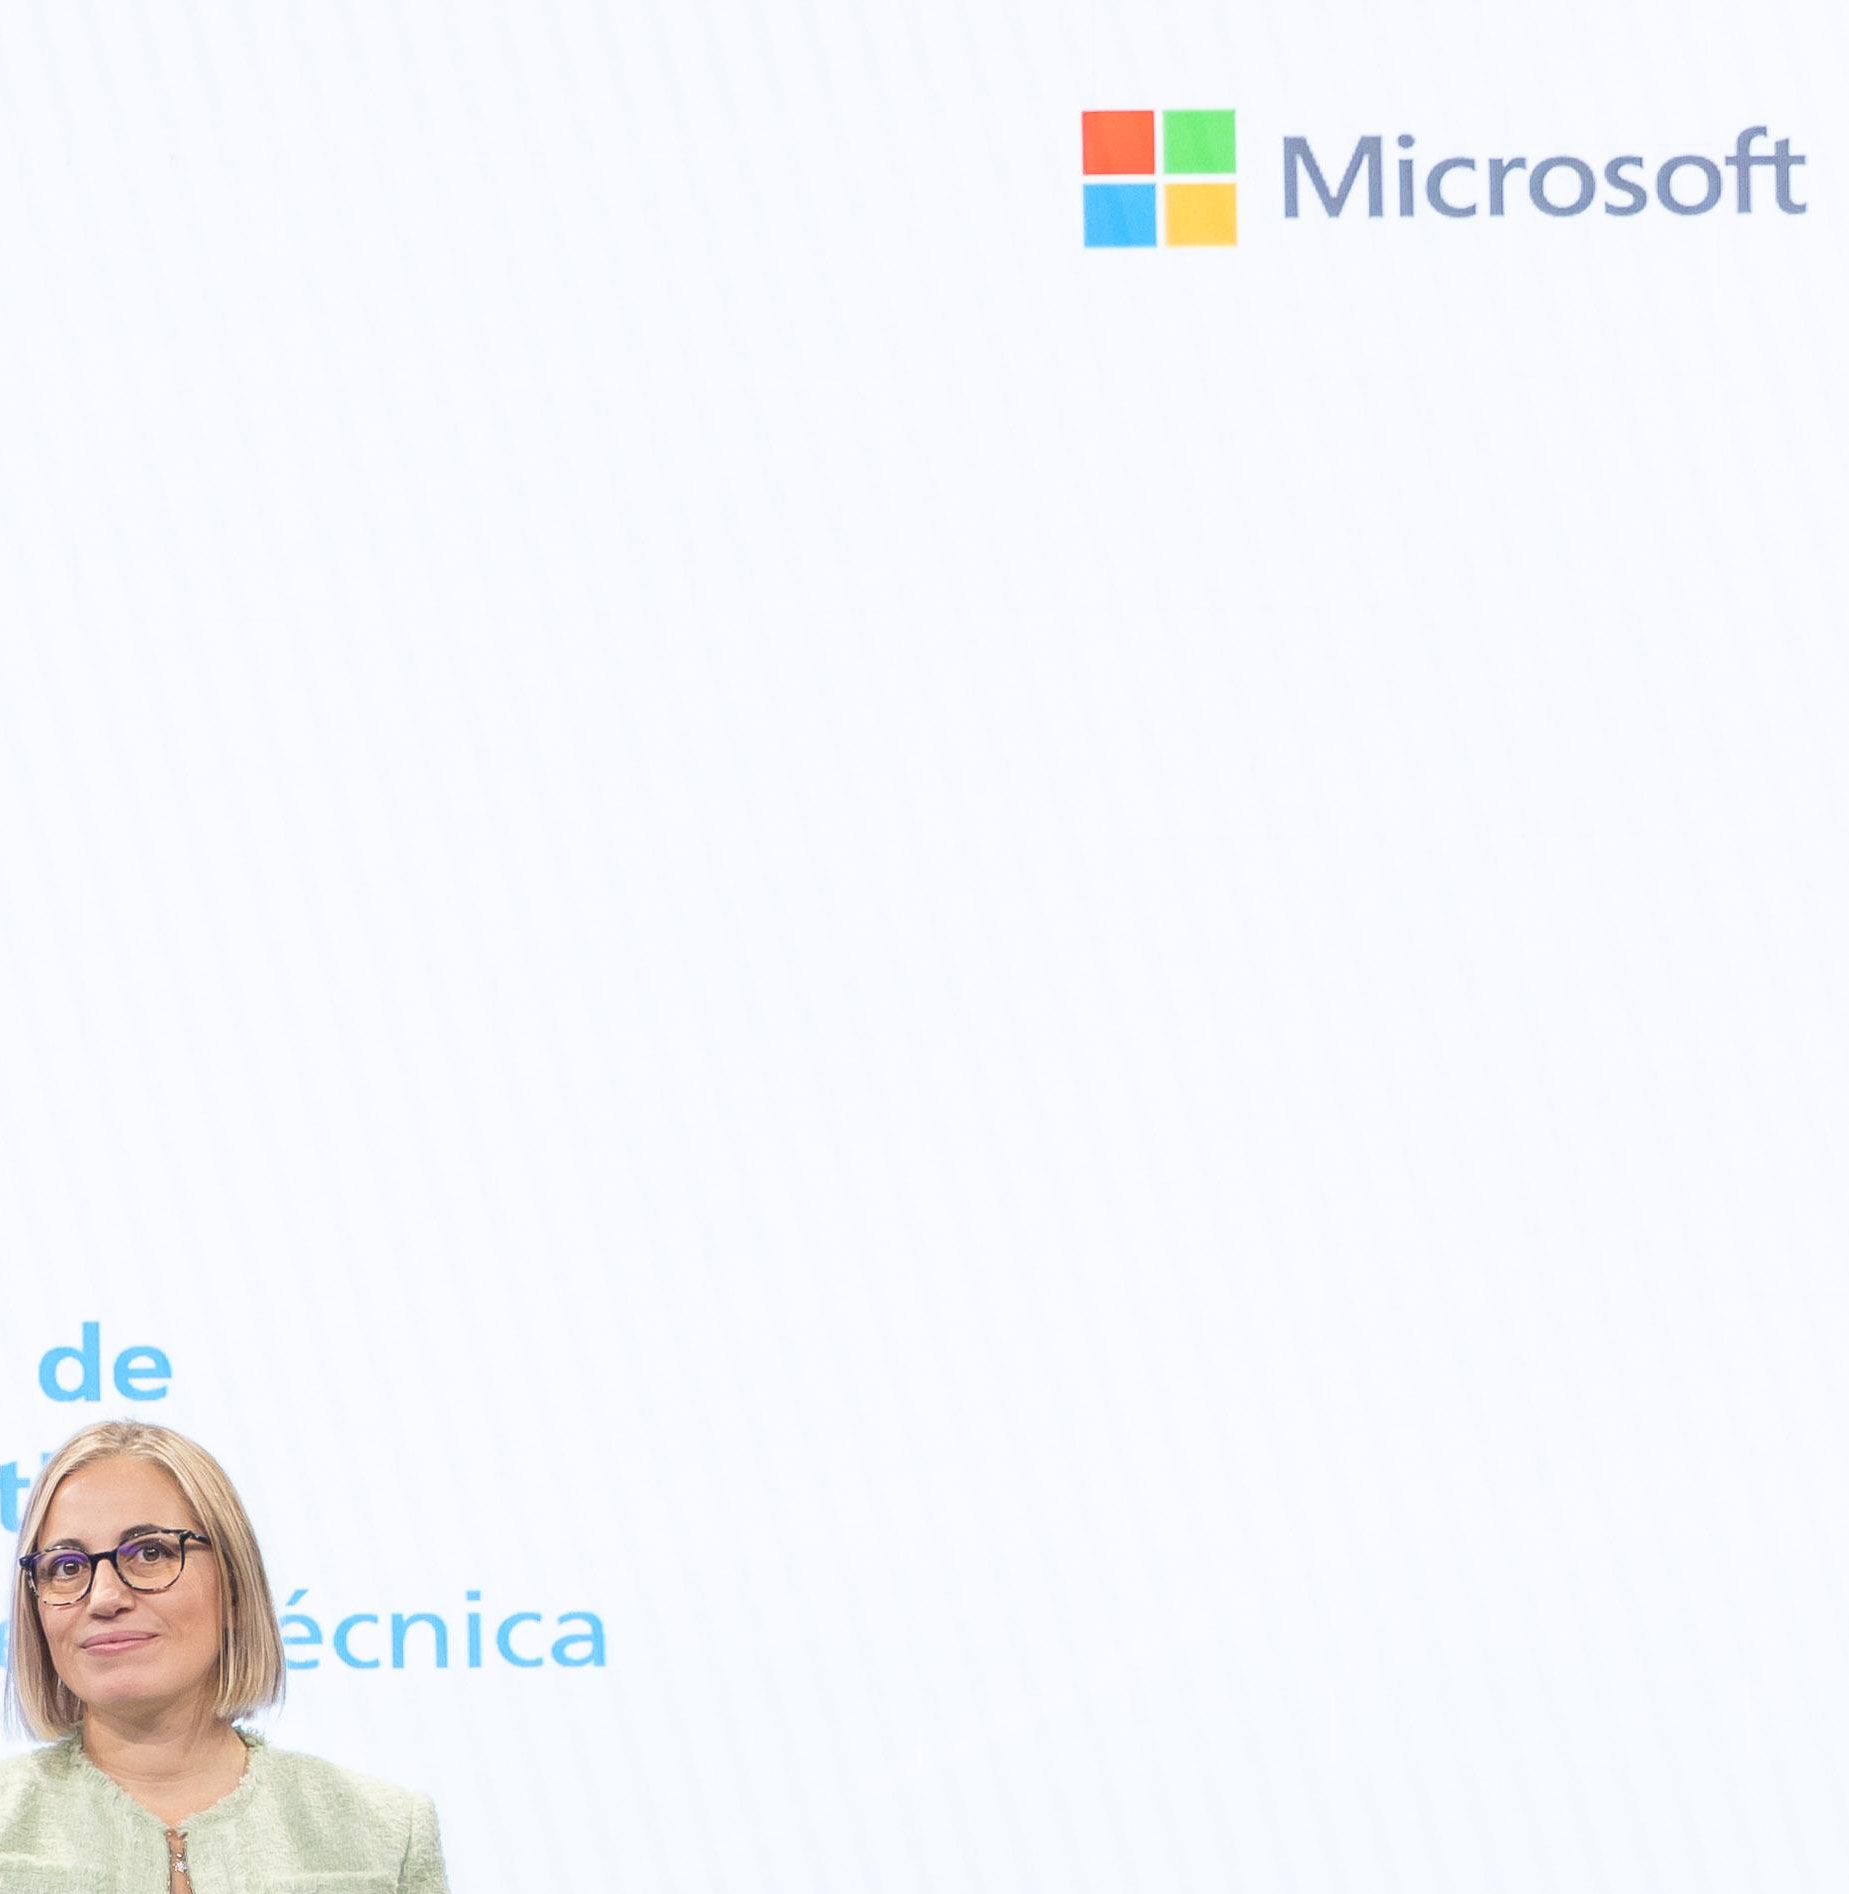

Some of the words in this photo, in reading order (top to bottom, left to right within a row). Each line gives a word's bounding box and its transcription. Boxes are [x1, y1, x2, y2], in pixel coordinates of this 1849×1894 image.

[1283, 125, 1808, 219] Microsoft
[38, 1320, 173, 1403] de
[280, 1588, 606, 1671] écnica
